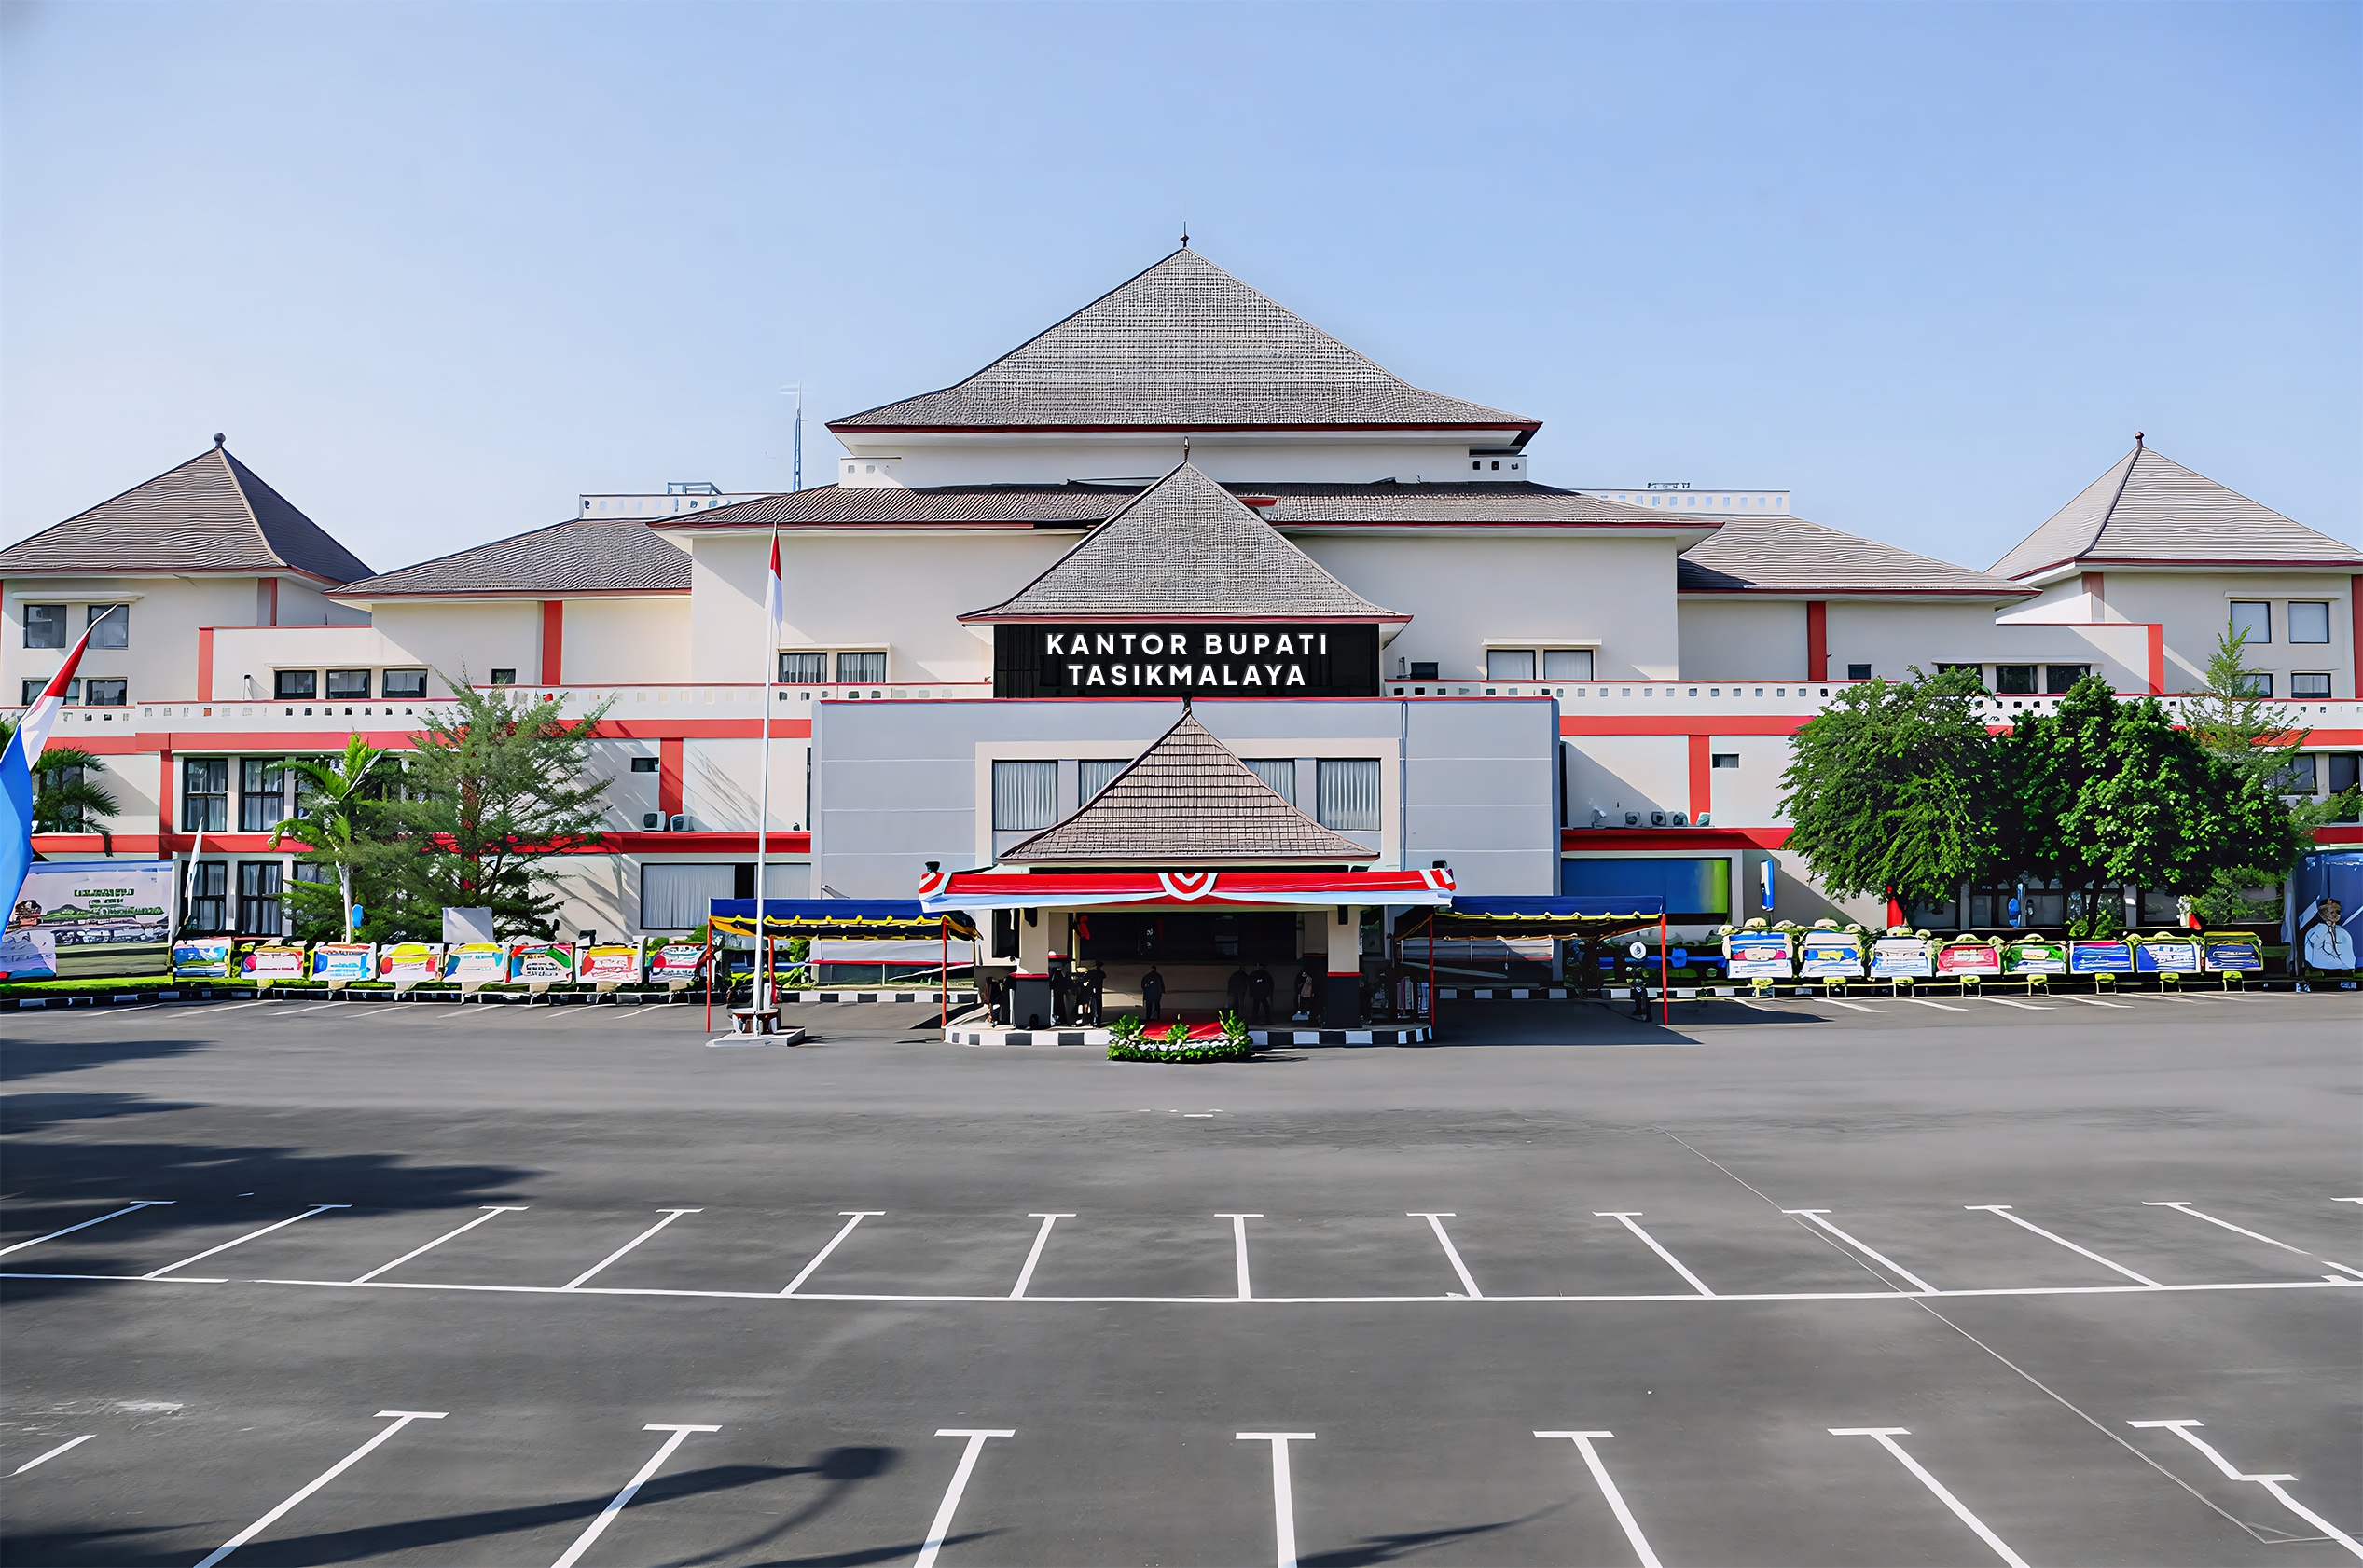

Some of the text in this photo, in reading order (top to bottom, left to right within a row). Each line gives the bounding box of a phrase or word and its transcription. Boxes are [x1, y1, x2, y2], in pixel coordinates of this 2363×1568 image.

[1046, 634, 1326, 655] KANTOR BUPATI
[1068, 665, 1306, 686] TASIKMALAYA
